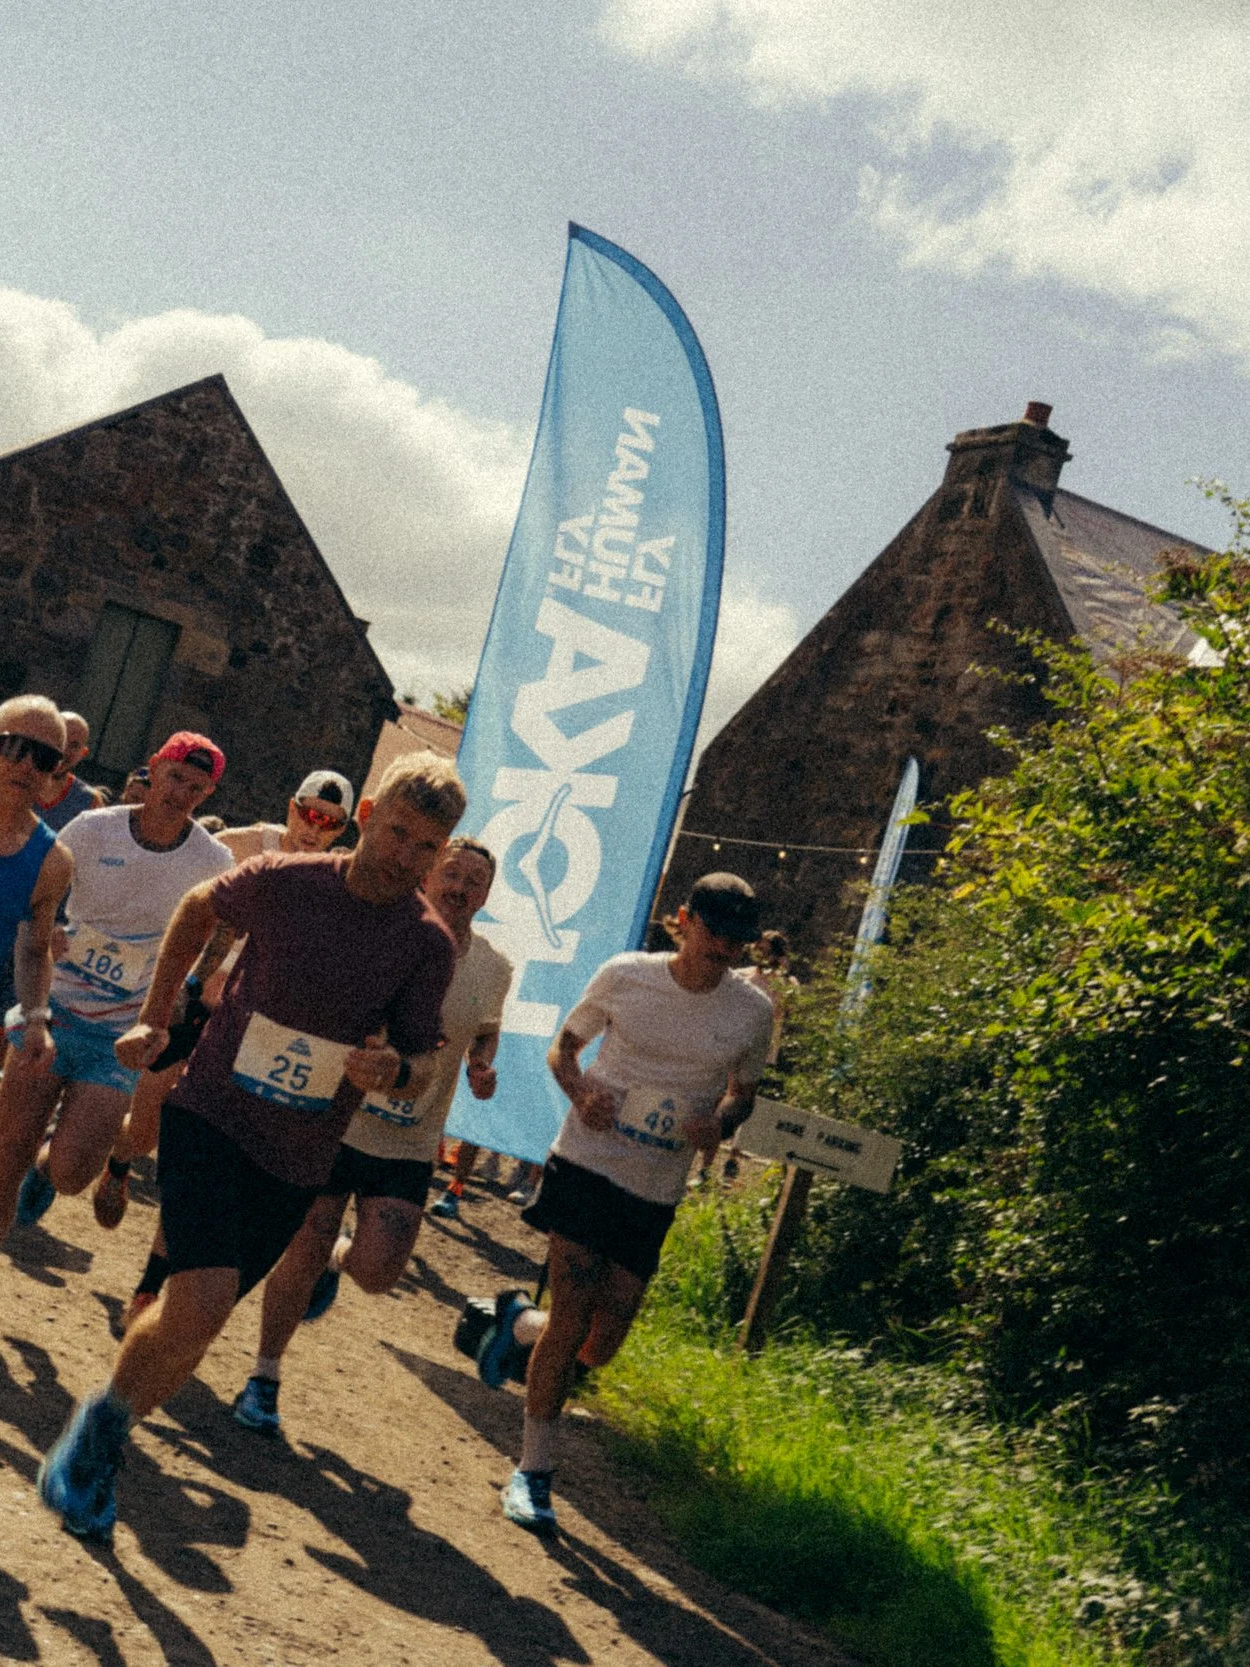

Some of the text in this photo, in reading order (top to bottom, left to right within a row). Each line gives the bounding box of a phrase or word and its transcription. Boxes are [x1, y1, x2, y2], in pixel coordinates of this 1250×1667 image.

[83, 947, 124, 982] 106
[267, 1054, 314, 1092] 25
[644, 1110, 675, 1134] 49
